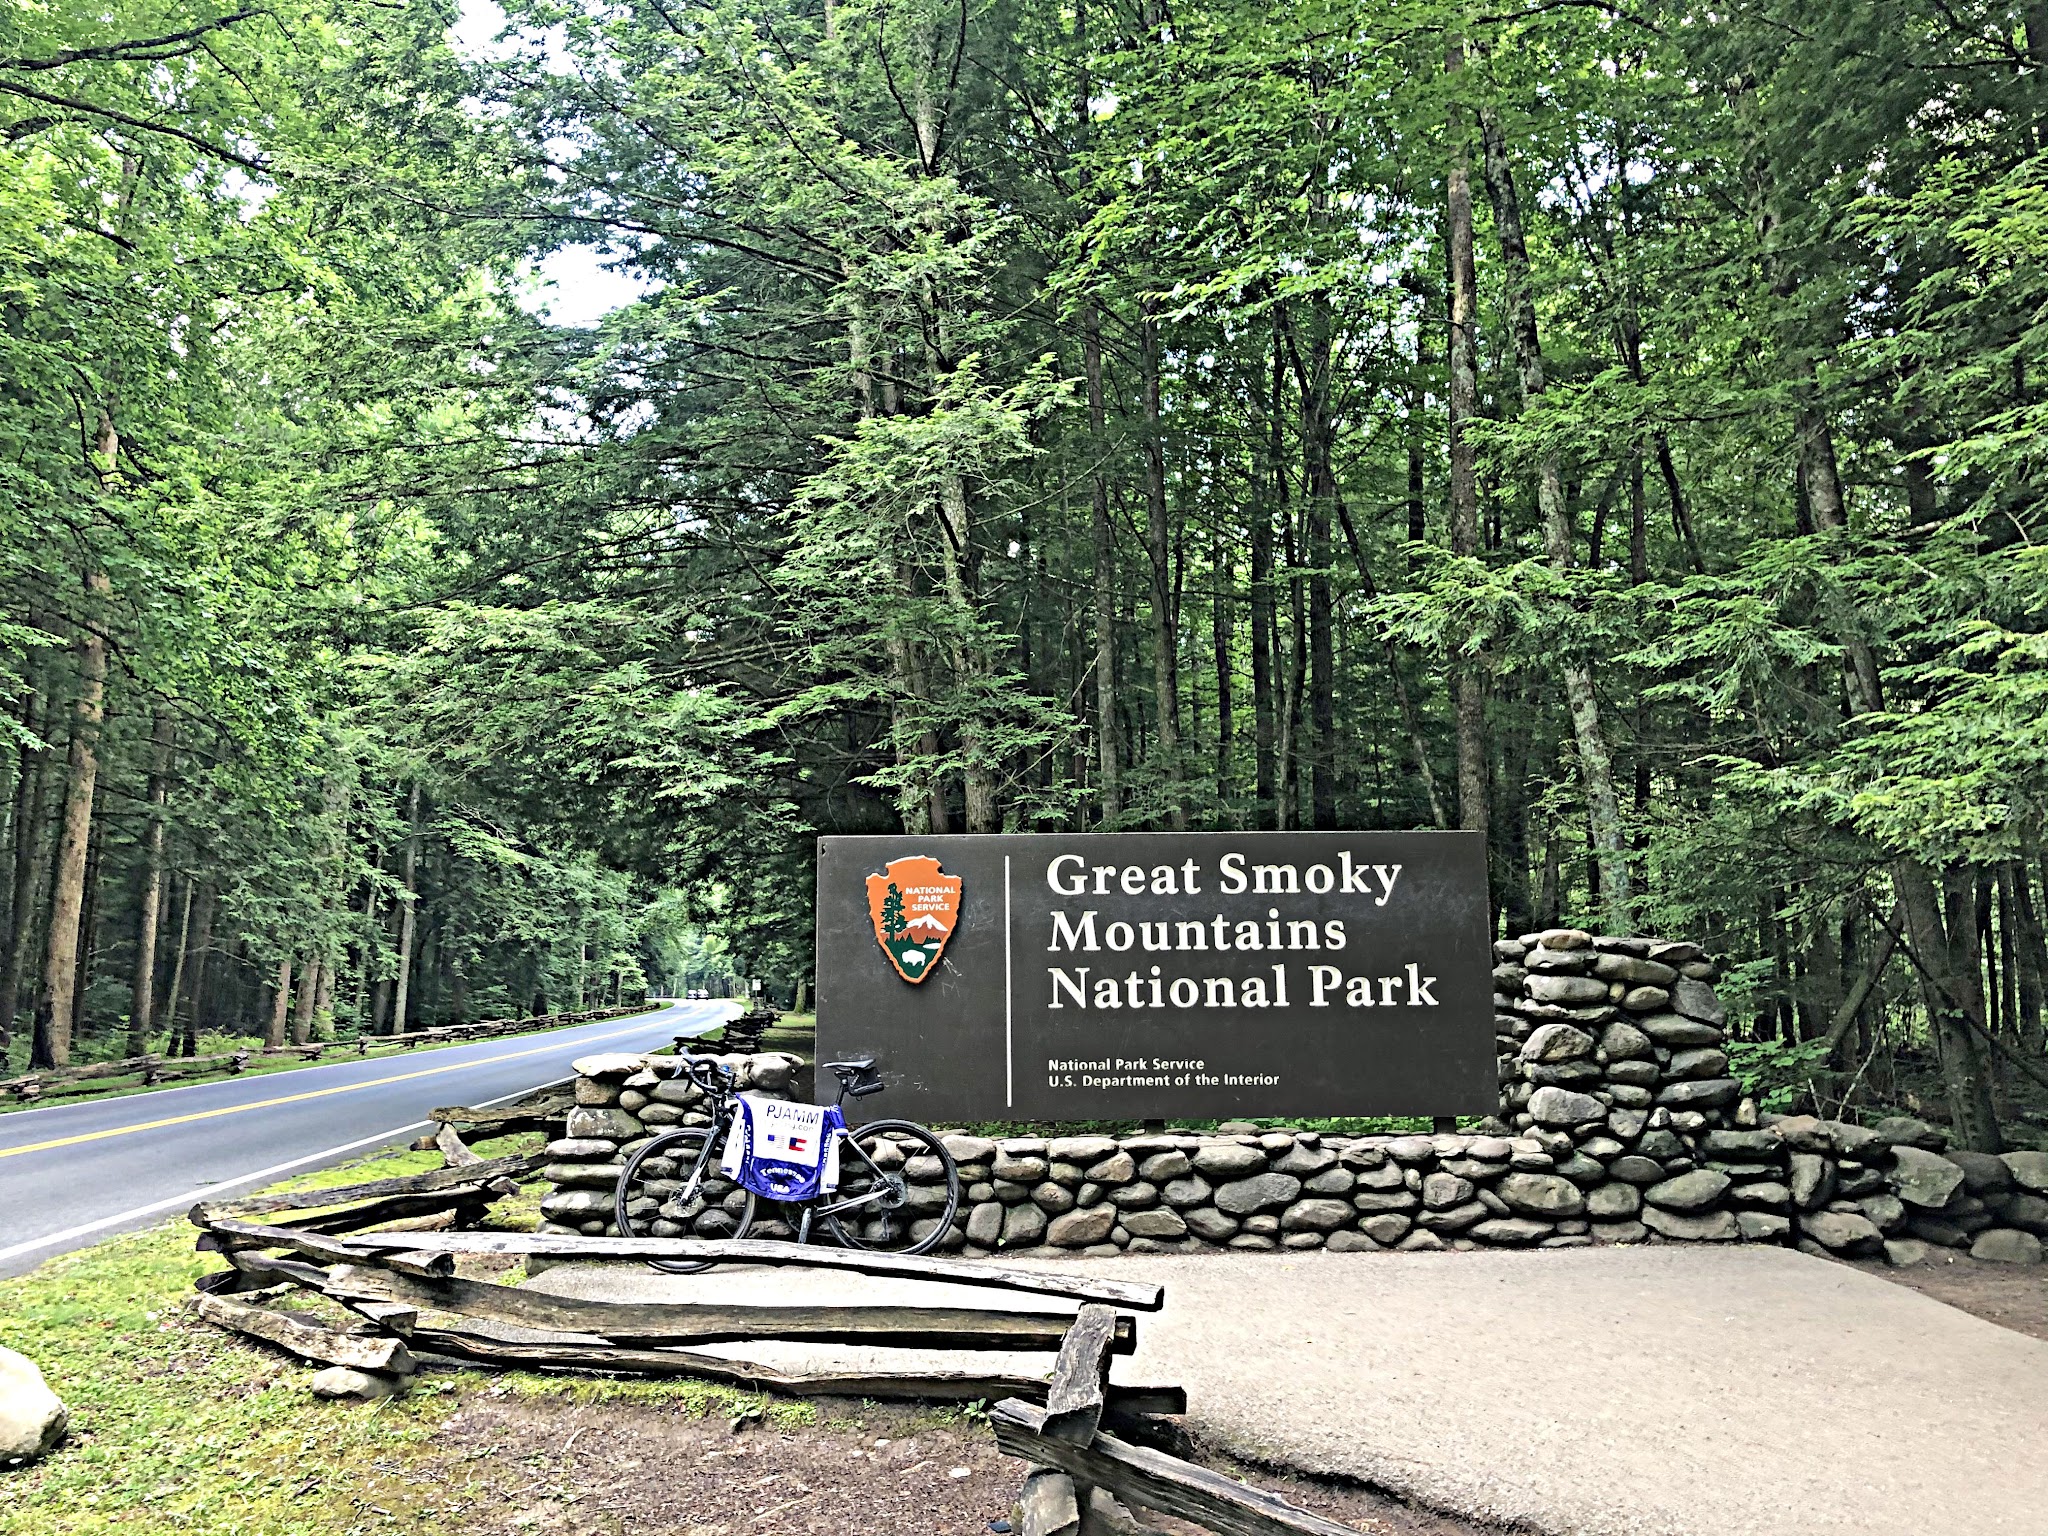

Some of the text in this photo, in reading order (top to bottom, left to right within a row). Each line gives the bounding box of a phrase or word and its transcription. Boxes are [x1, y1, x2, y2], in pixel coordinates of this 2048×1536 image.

[1046, 850, 1403, 907] Great Smoky
[905, 886, 956, 894] NATIONAL
[917, 894, 944, 903] PARK
[911, 903, 950, 911] SERVICE
[1046, 910, 1347, 952] Mountains
[1047, 962, 1440, 1009] National Park
[1048, 1057, 1205, 1072] National Park Service
[1048, 1072, 1280, 1090] U.S. Department of the Interior
[766, 1104, 820, 1125] PJAMM
[770, 1182, 790, 1194] USA
